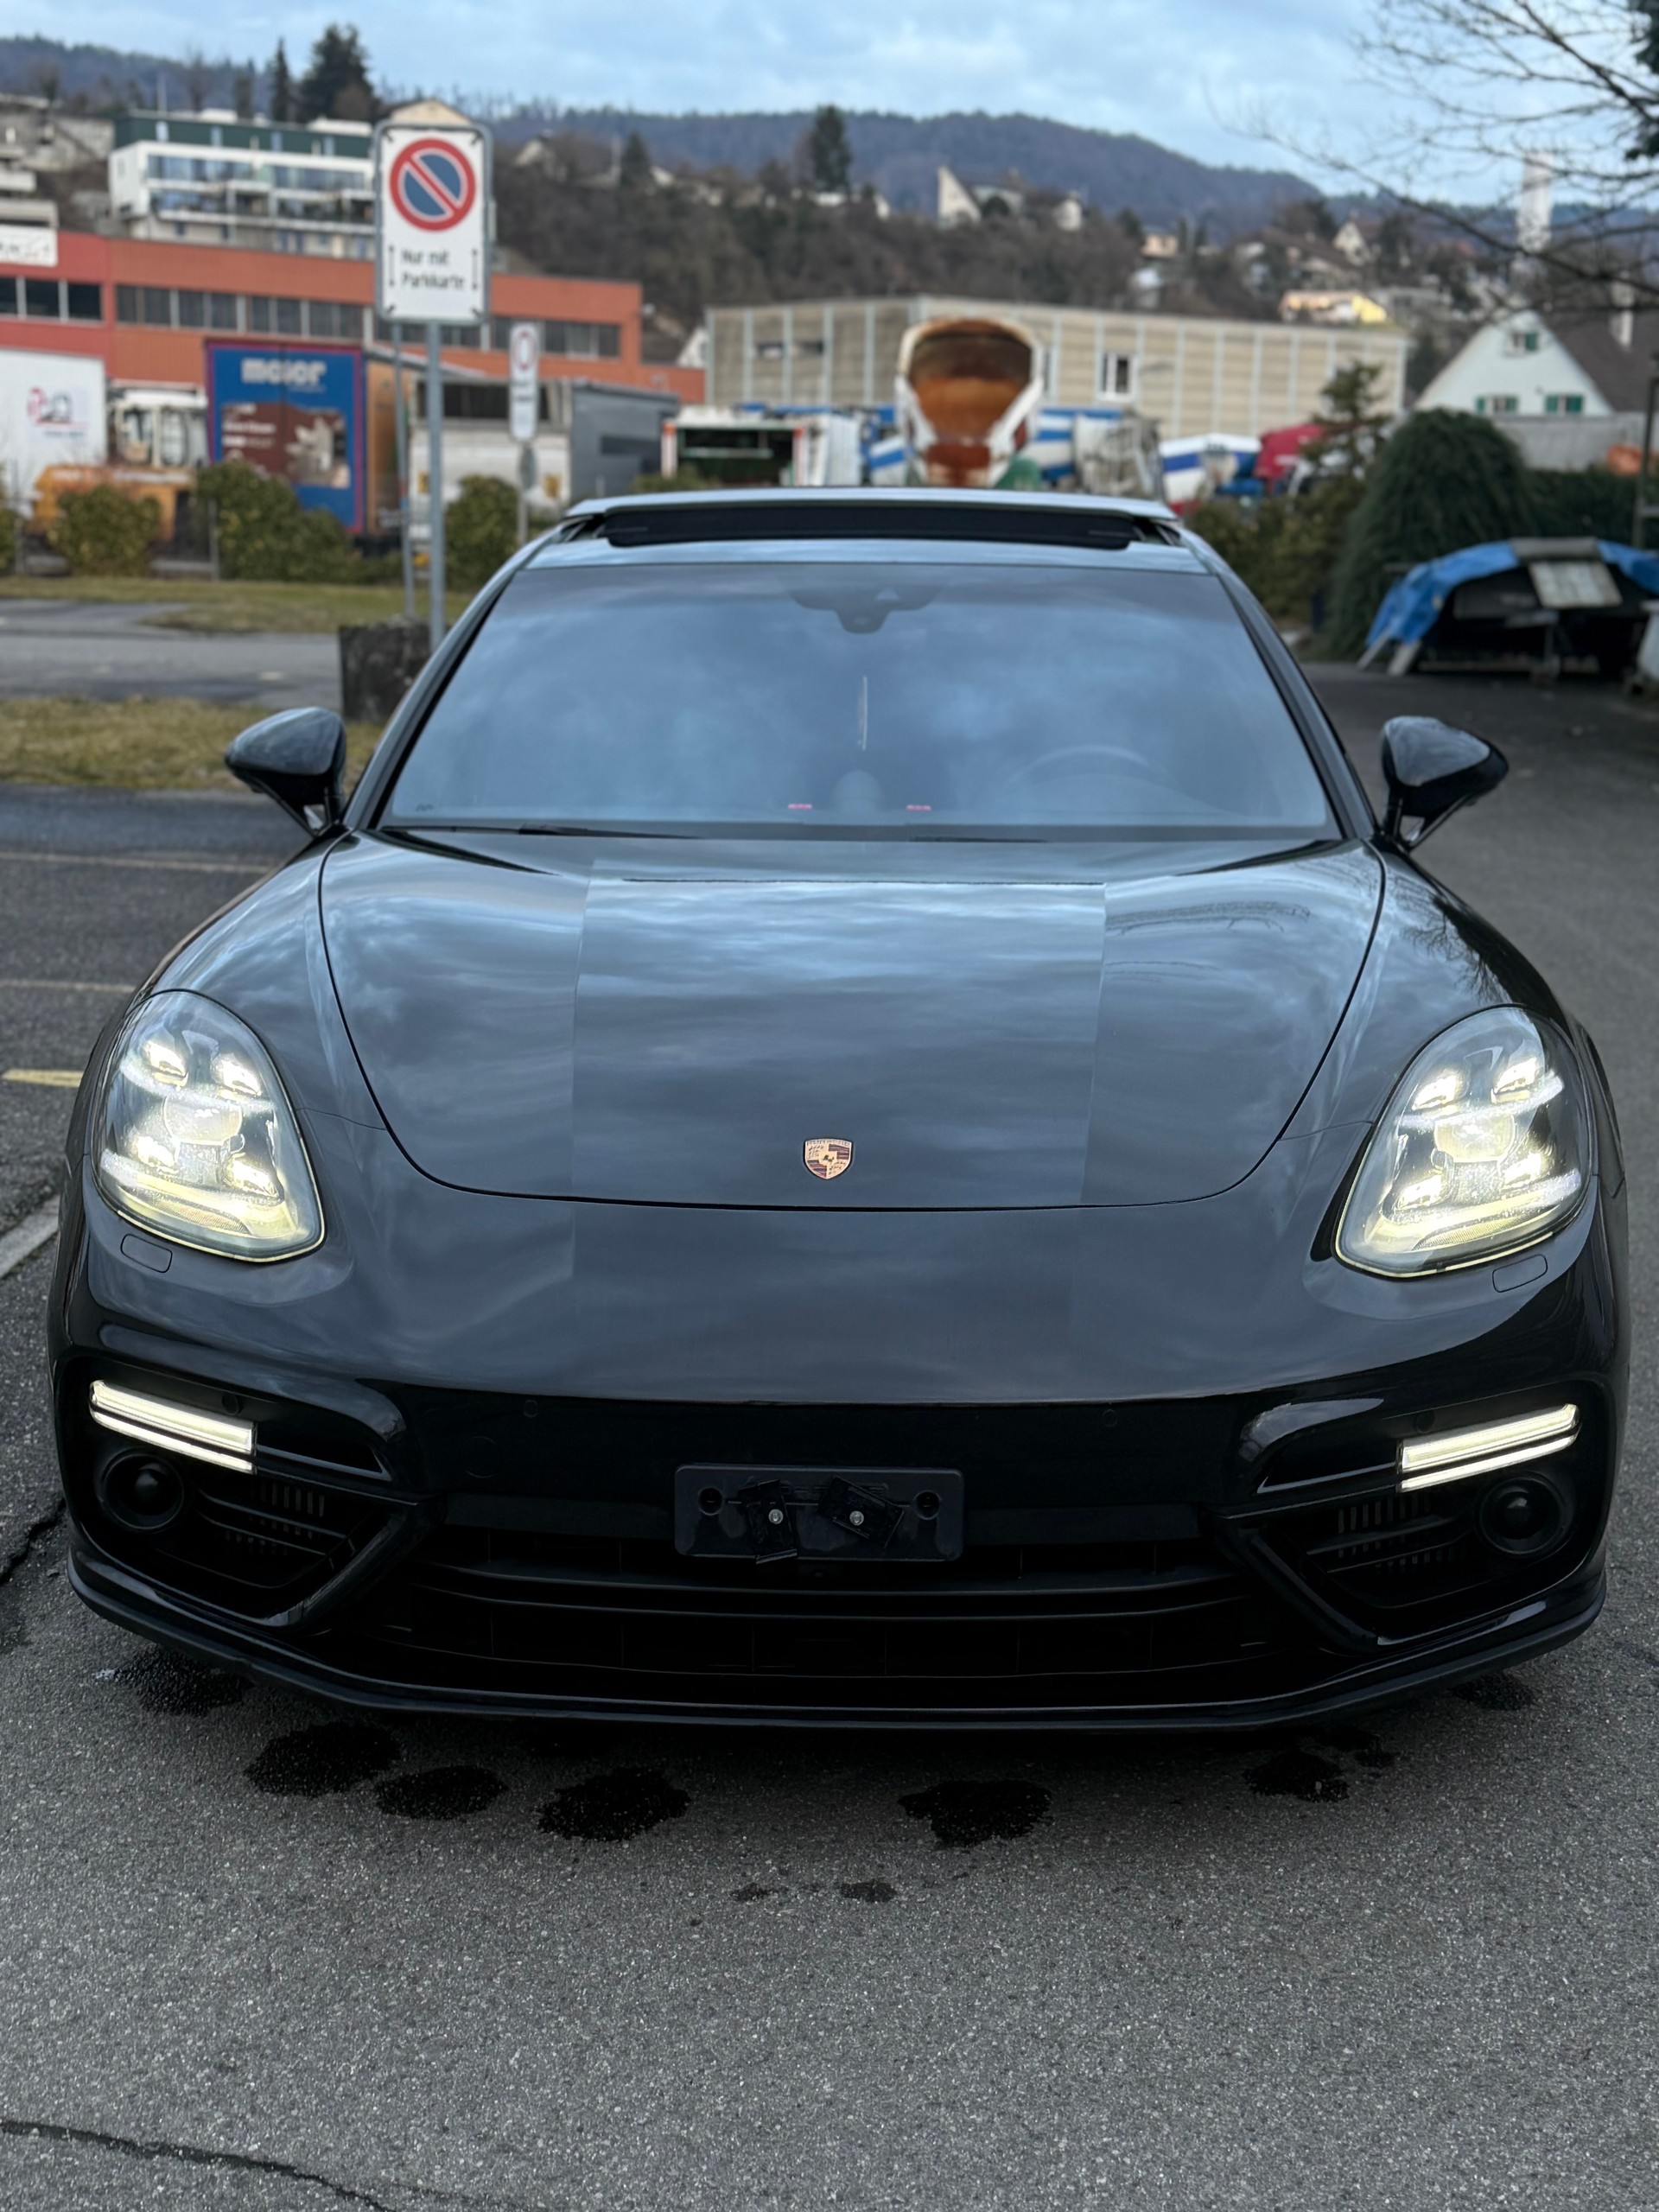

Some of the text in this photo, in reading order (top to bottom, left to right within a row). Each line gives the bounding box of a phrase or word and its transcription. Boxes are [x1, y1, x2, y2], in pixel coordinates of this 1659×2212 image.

[401, 248, 449, 265] Nur mit
[401, 270, 466, 290] Parkkarte
